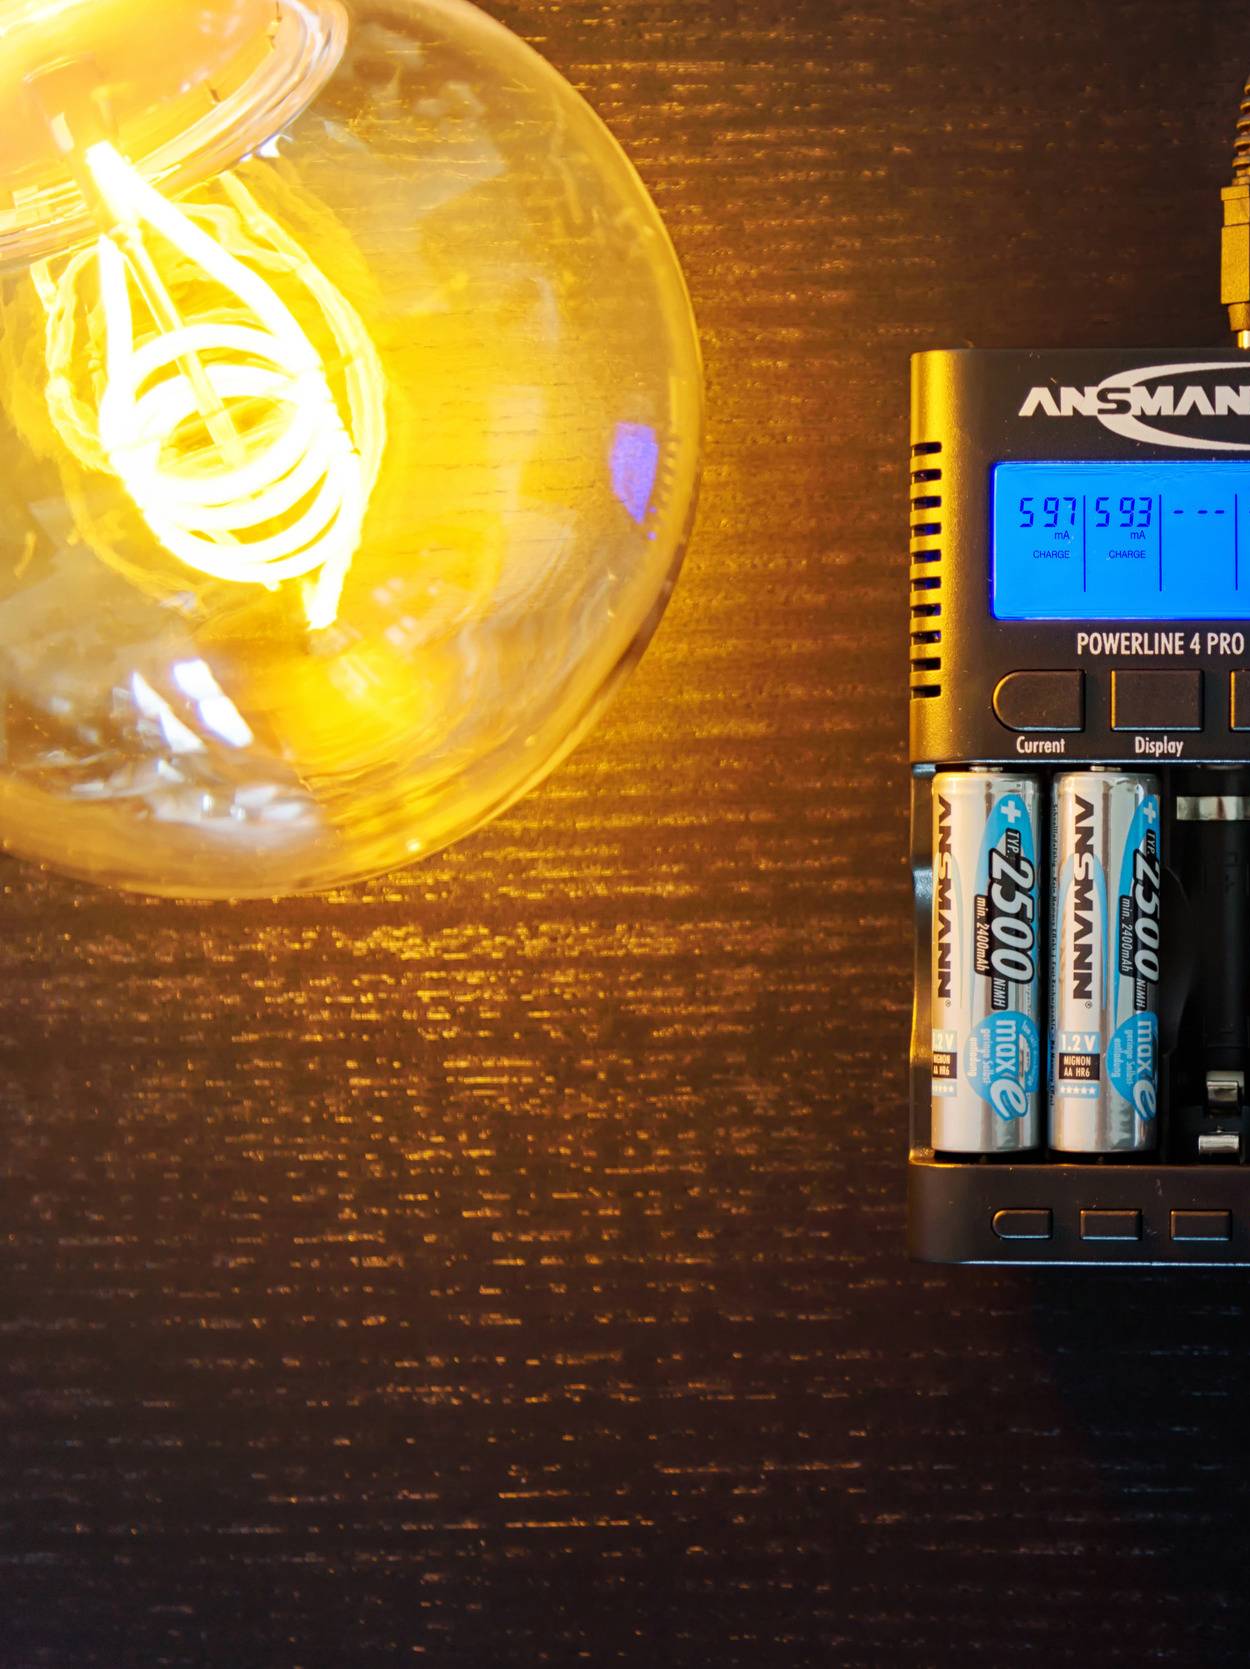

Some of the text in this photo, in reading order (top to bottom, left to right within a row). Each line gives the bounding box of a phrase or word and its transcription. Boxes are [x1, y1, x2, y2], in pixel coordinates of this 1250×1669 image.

[1019, 496, 1077, 528] 597
[1095, 496, 1153, 528] 593
[1054, 530, 1146, 540] mA mA
[1032, 550, 1147, 559] CHARGE CHARGE
[1077, 632, 1245, 656] POWERLINE 4 PRO
[1016, 736, 1066, 754] Current
[1134, 736, 1184, 758] Display
[1007, 831, 1020, 853] TYP.
[1147, 832, 1156, 855] TYP.
[990, 849, 1034, 981] 2500
[1134, 850, 1160, 982] 2500
[975, 897, 989, 971] min. 2400mAh
[1121, 897, 1133, 972] min. 2400mAh
[993, 978, 1007, 1007] NiMH
[1136, 979, 1147, 1008] NiMH
[995, 1019, 1017, 1072] max
[1060, 1034, 1096, 1051] 1.2 V
[1137, 1020, 1153, 1071] max
[1063, 1055, 1091, 1066] MIGNON
[1064, 1067, 1090, 1077] AA HR6
